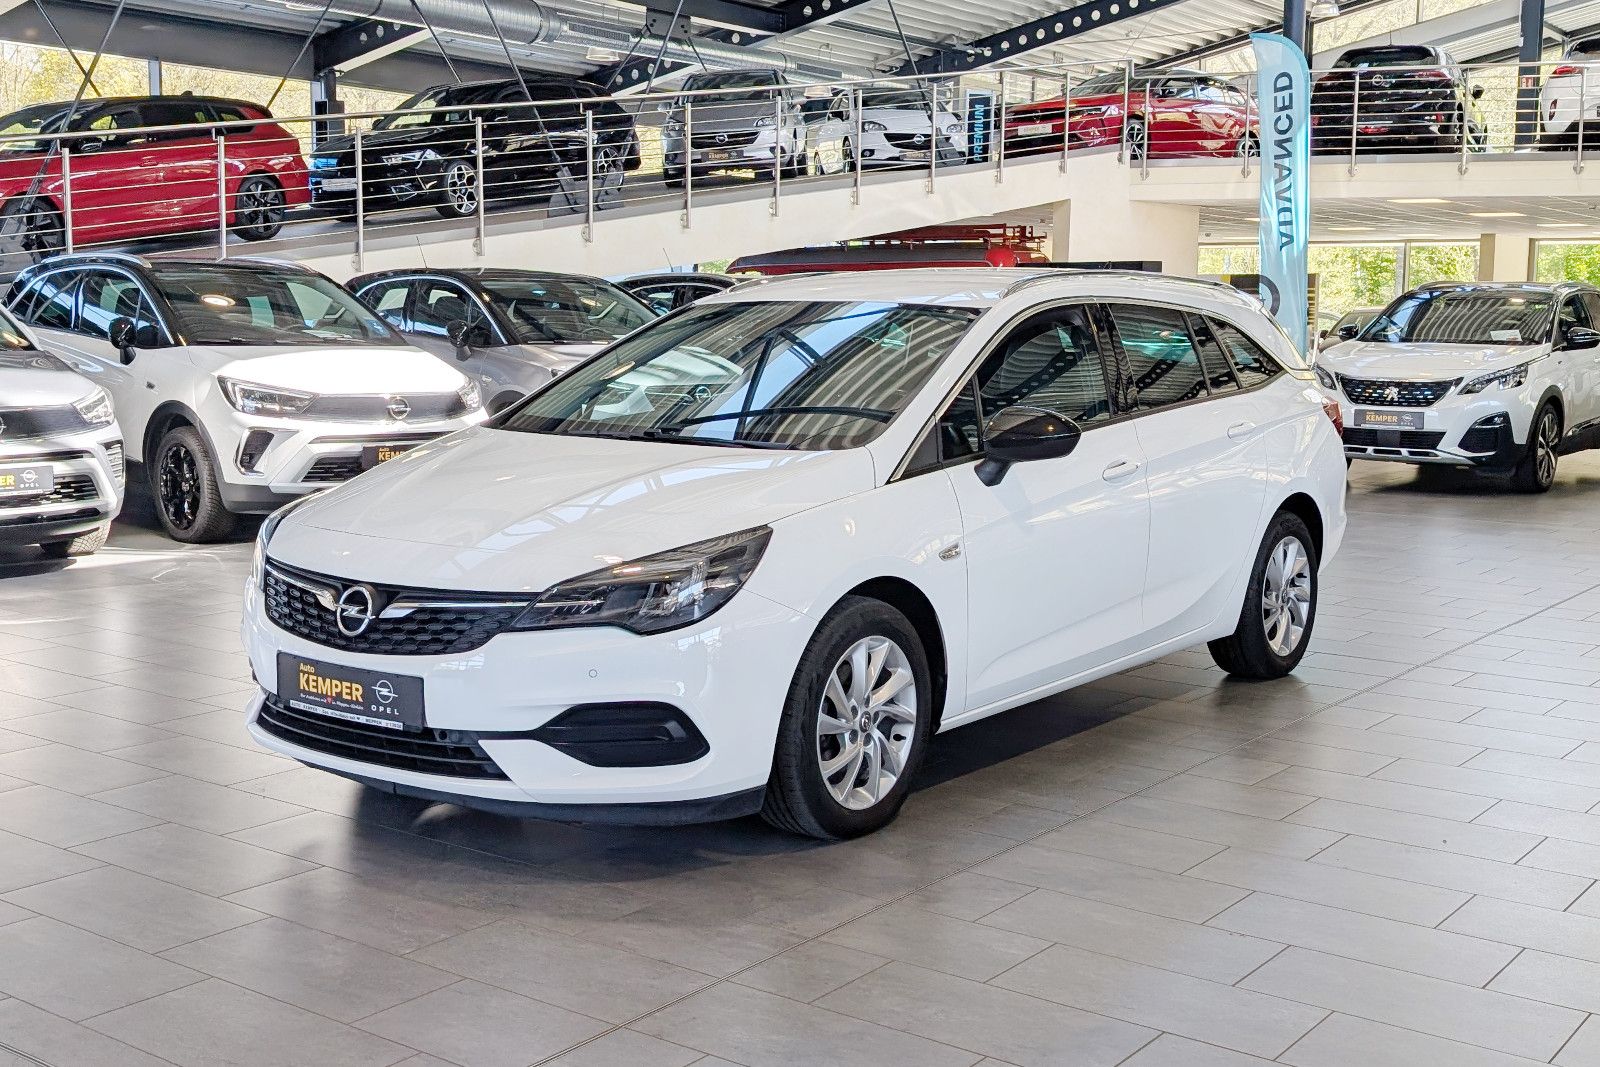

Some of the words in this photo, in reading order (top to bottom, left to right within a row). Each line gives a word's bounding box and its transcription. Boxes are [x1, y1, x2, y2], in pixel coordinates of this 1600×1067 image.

[973, 104, 984, 162] PREMIUM
[1366, 414, 1398, 423] KEMPER
[379, 451, 405, 461] KEM
[299, 662, 315, 673] Auto
[300, 672, 364, 703] KEMPER
[371, 704, 399, 715] OPEL
